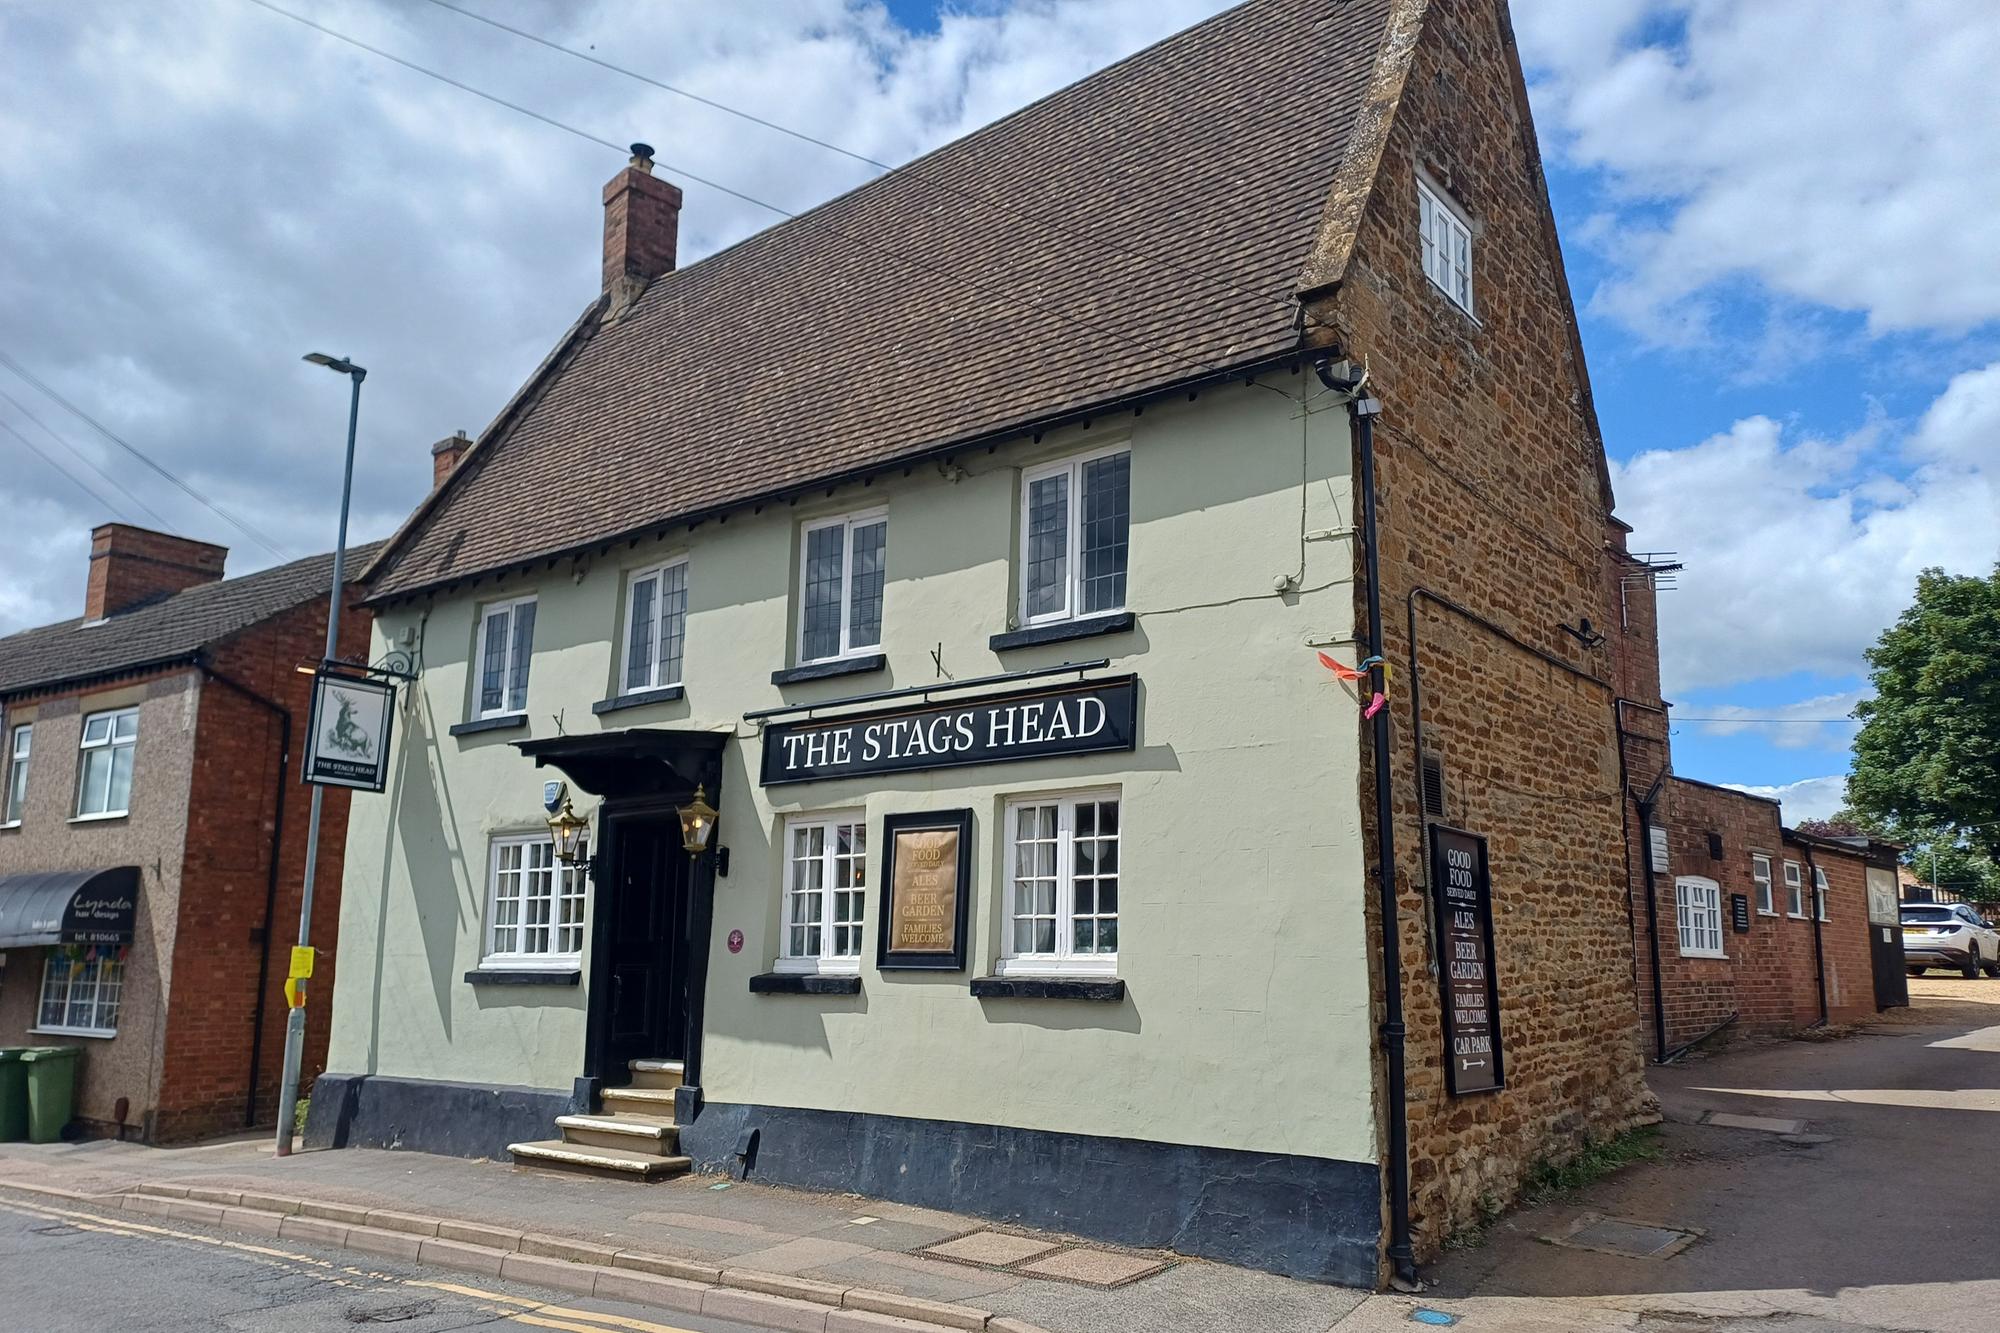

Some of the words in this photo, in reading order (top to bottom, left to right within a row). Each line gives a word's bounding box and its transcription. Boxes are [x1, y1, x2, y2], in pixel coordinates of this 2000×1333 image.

[783, 728, 853, 770] THE
[862, 712, 974, 761] STAGS
[986, 697, 1107, 748] HEAD
[316, 760, 332, 769] THE
[333, 763, 354, 772] STAGS
[355, 766, 375, 775] HEAD
[912, 837, 942, 850] GOOD
[912, 850, 941, 861] FOOD
[1448, 849, 1471, 869] GOOD
[912, 874, 938, 887] ALES
[1449, 868, 1472, 887] FOOD
[911, 893, 937, 905] BEER
[1446, 887, 1464, 899] SERVED
[1464, 889, 1476, 900] DAILY
[73, 895, 132, 914] Lynda
[902, 905, 945, 917] GARDEN
[75, 910, 90, 918] hair
[94, 910, 120, 920] design
[1454, 911, 1474, 929] ALES
[904, 924, 942, 933] FAMILIES
[901, 933, 944, 943] WELCOME
[1455, 942, 1477, 960] BEER
[1450, 961, 1484, 979] GARDEN
[1455, 993, 1484, 1007] FAMILIES
[1454, 1009, 1487, 1023] WELCOME
[1454, 1037, 1471, 1055] CAR
[1472, 1036, 1491, 1053] PARK
